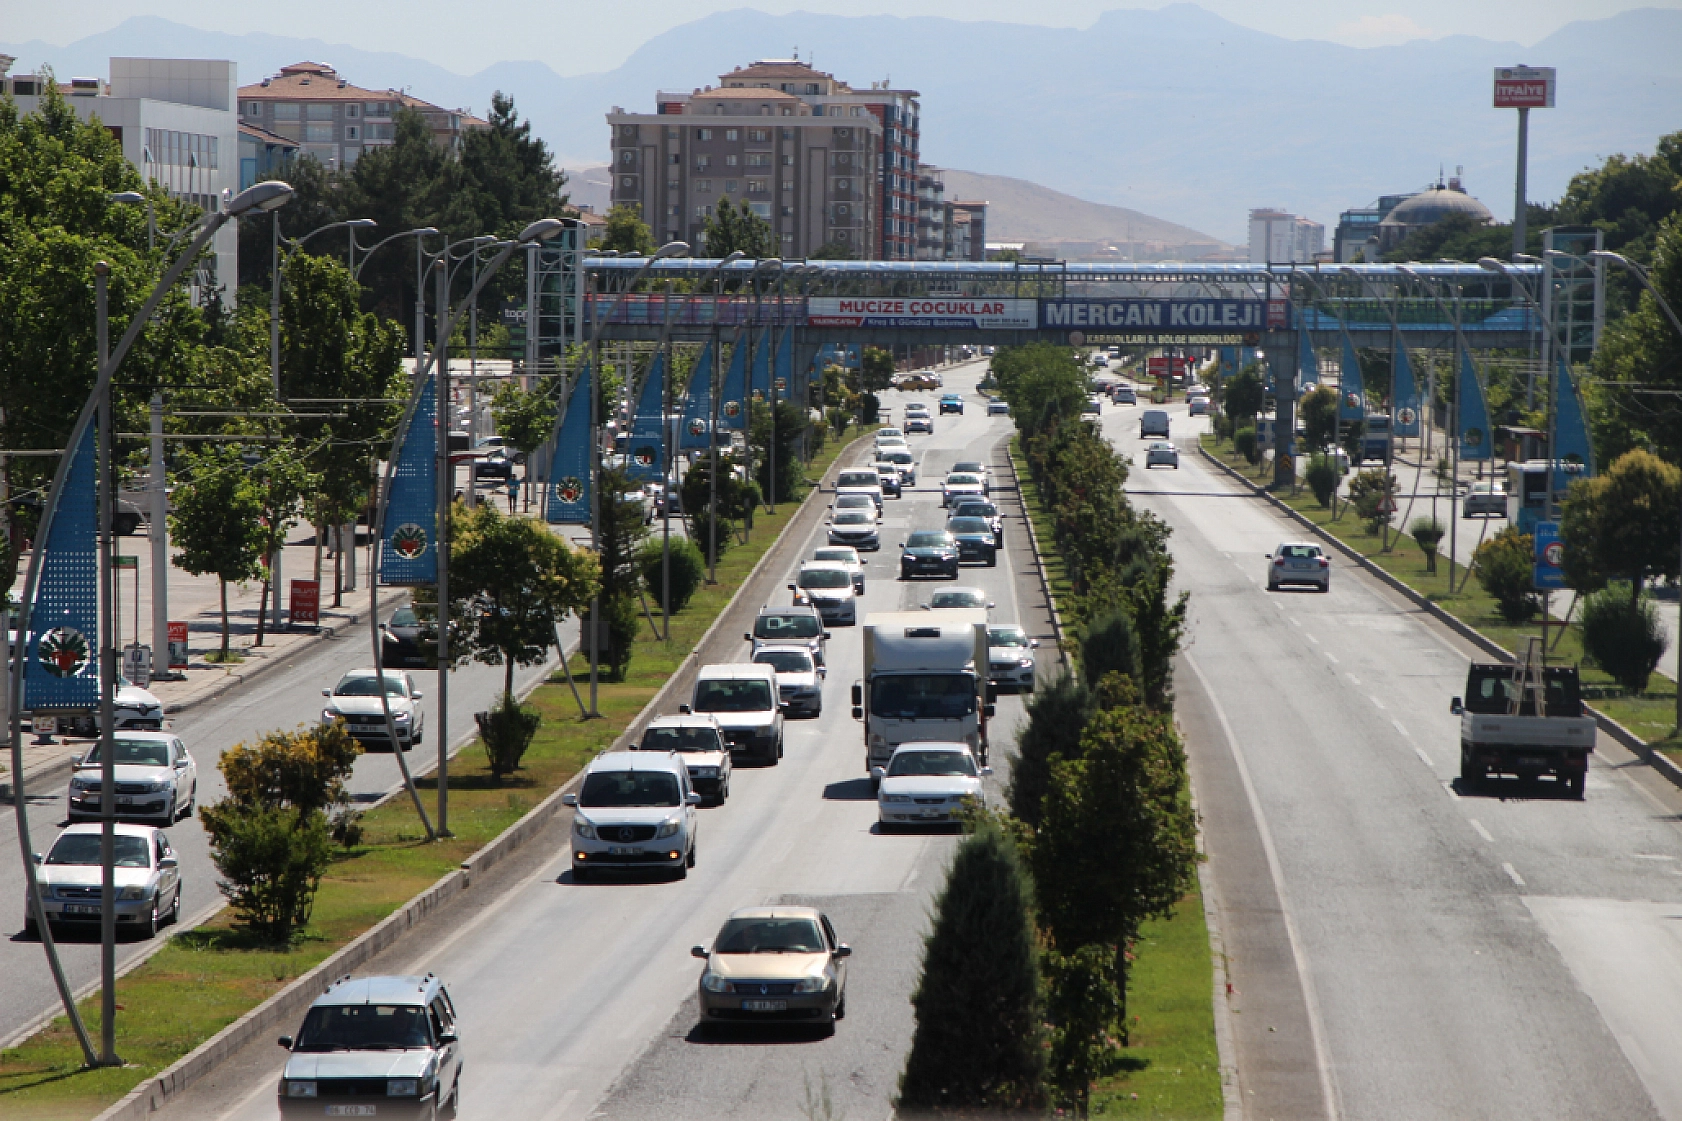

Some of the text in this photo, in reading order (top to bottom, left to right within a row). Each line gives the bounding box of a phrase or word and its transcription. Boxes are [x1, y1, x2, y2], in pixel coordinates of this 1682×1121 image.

[909, 302, 1005, 316] ÇOCUKLAR
[1046, 303, 1162, 326] MERCAN
[898, 318, 931, 326] Gündüz
